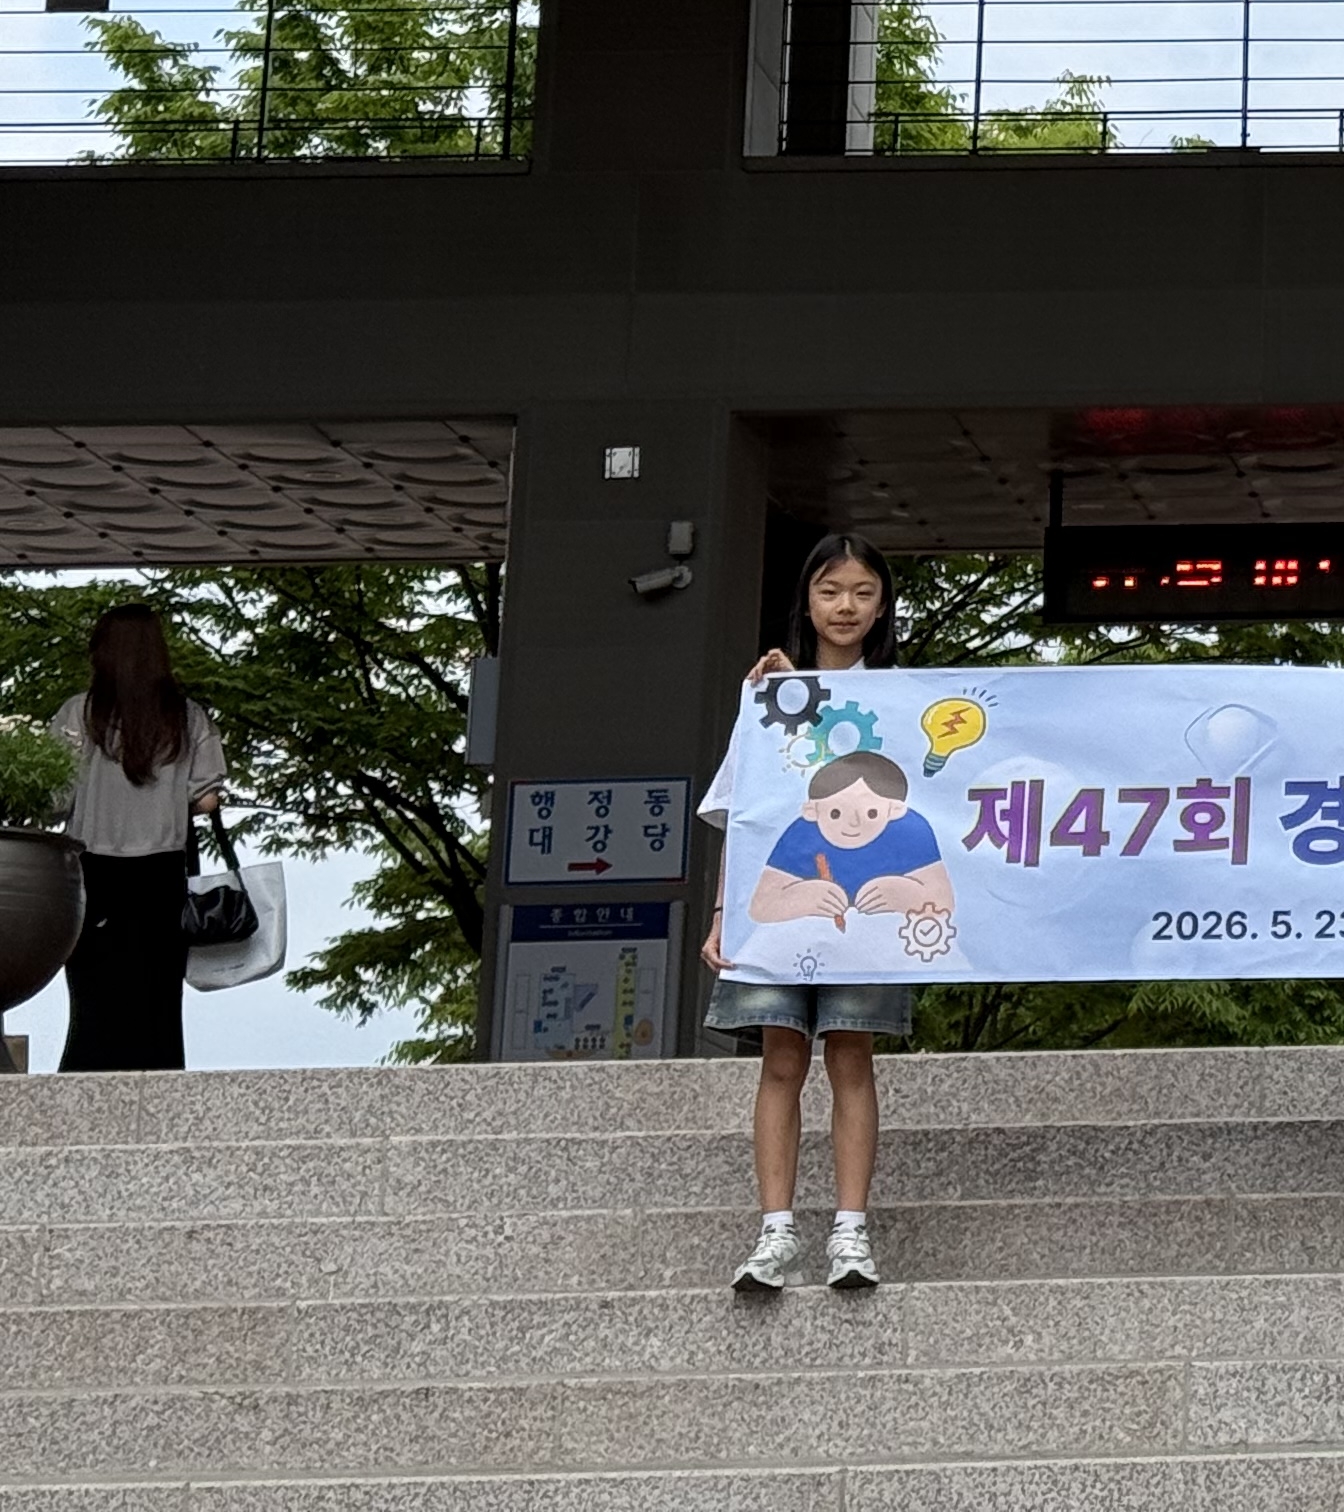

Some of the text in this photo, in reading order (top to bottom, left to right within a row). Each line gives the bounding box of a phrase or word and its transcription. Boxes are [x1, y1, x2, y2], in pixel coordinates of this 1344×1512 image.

[961, 774, 1252, 868] 제47회
[1151, 909, 1259, 941] 2026.
[1270, 909, 1303, 940] 5.
